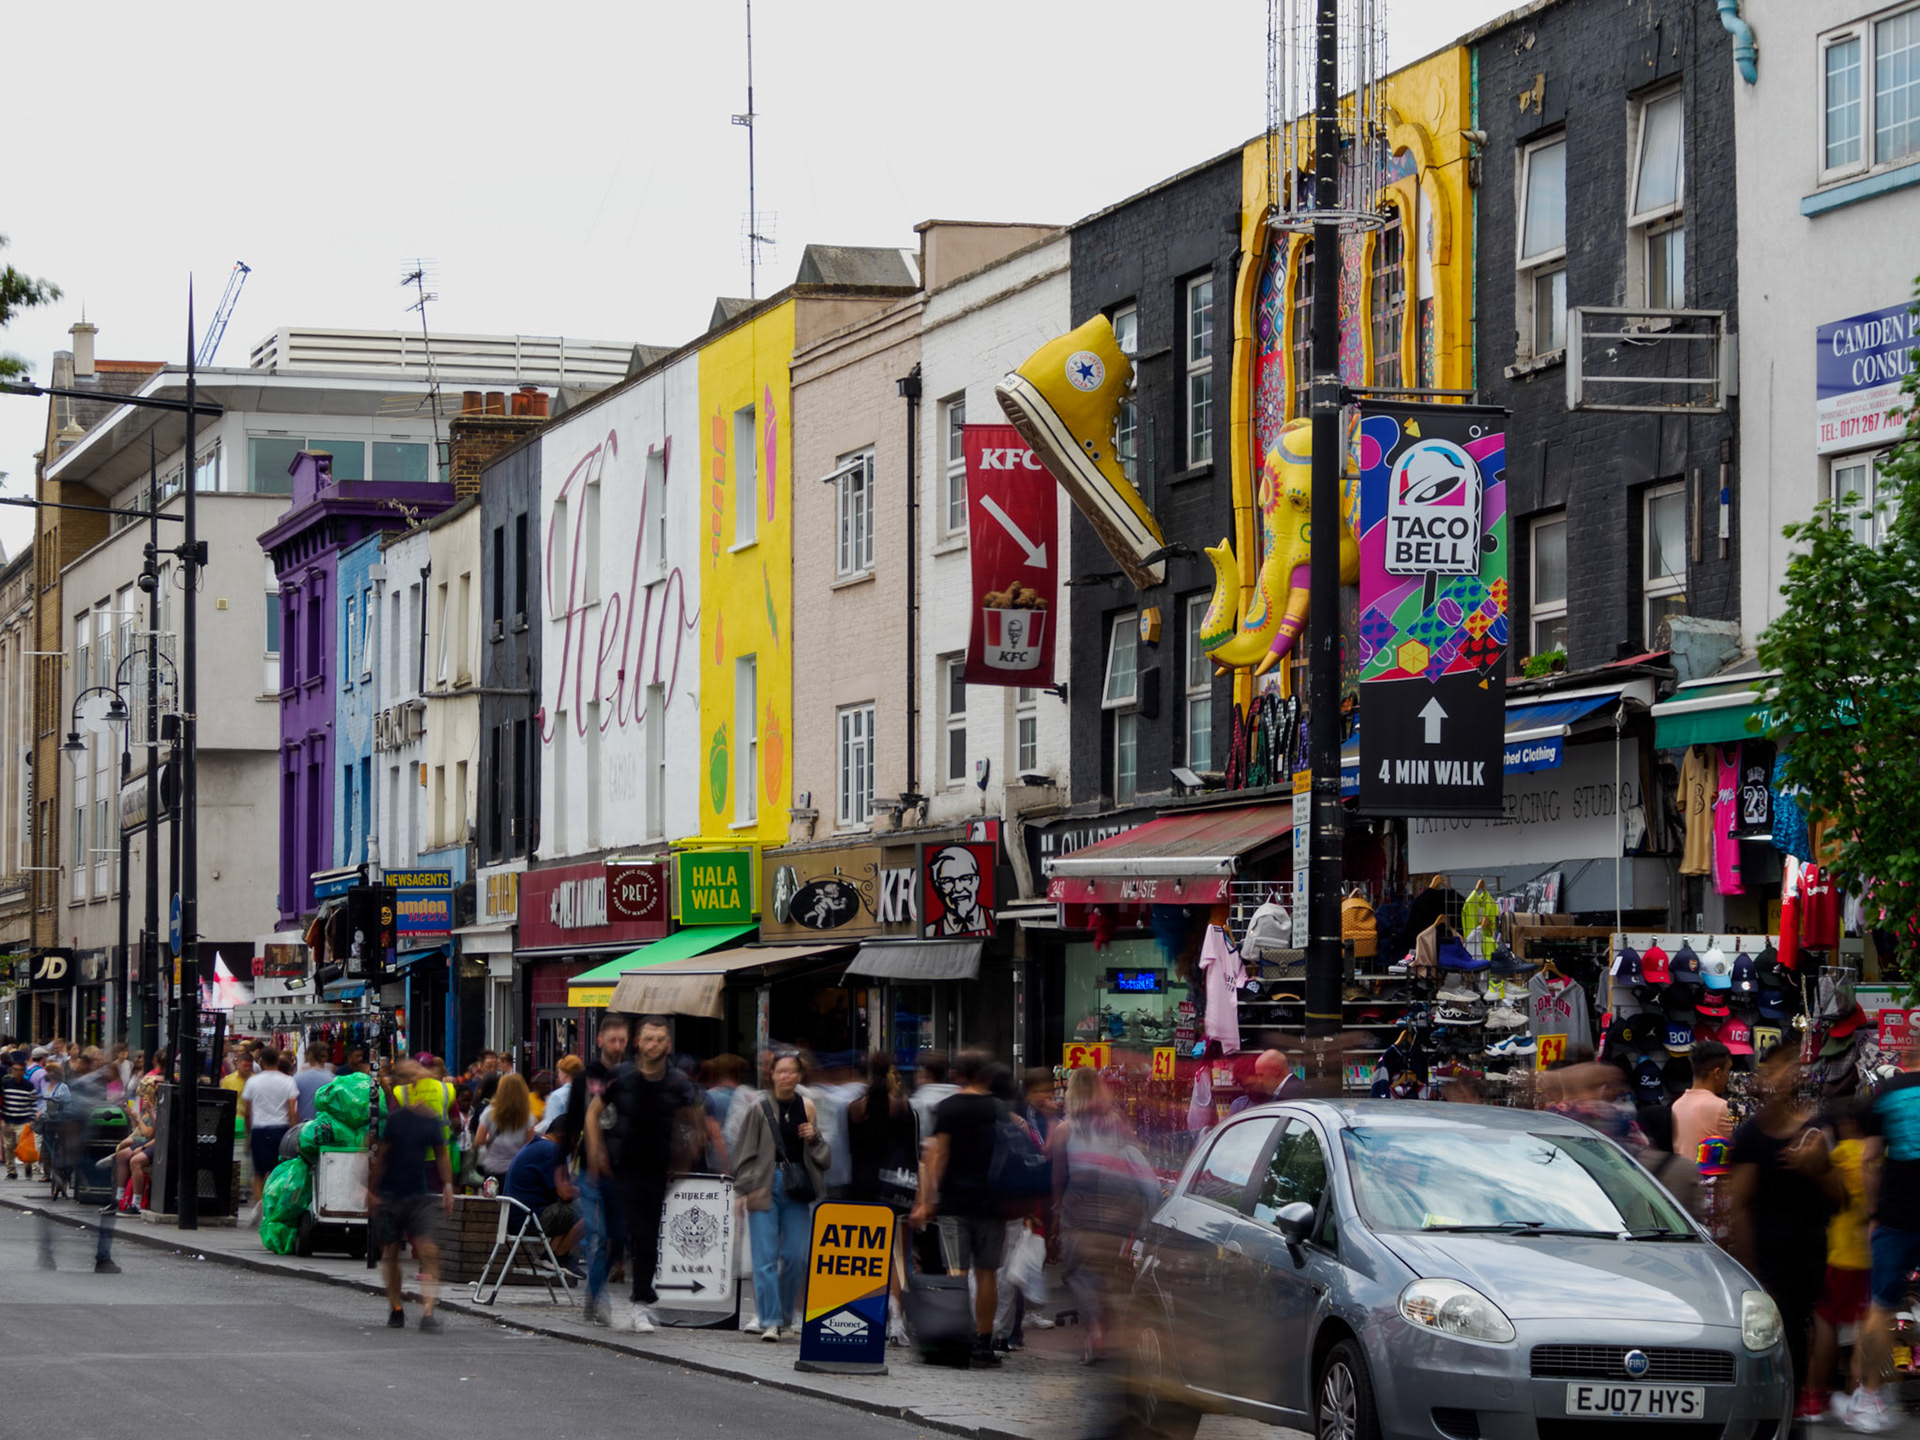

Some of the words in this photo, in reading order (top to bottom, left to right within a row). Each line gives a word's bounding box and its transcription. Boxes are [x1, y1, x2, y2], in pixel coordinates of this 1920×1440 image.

[1832, 314, 1904, 357] CAMDEN
[1852, 345, 1916, 386] CONSUL
[1821, 422, 1838, 442] TEL:
[1840, 418, 1860, 438] 0171
[1862, 412, 1880, 433] 267
[979, 448, 1043, 471] KFC
[1391, 516, 1469, 540] TACO
[1395, 542, 1466, 564] BELL
[535, 429, 700, 744] Hello
[999, 650, 1029, 663] KFC
[1522, 746, 1557, 763] Clothing
[1379, 759, 1391, 784] 4
[1396, 759, 1430, 785] MIN
[1433, 760, 1486, 786] WALK
[1743, 785, 1769, 824] 23
[386, 873, 449, 887] NEWSAGENTS
[613, 869, 636, 886] ORGANIC
[636, 869, 656, 885] COFFEE
[692, 866, 738, 887] HALA
[622, 884, 649, 902] PRET
[691, 888, 741, 910] WALA
[1050, 880, 1066, 898] 243
[397, 898, 447, 916] amden
[408, 910, 449, 922] news
[613, 896, 631, 915] FRESHLY
[632, 908, 648, 916] MADE
[646, 896, 658, 911] FOOD
[34, 956, 68, 980] JD
[1669, 1030, 1692, 1044] BOY
[1069, 1046, 1102, 1070] £1
[1155, 1051, 1171, 1075] £1
[1541, 1039, 1563, 1067] £1
[819, 1223, 886, 1250] ATM
[671, 1264, 714, 1275] KARMA
[816, 1254, 884, 1277] HERE
[828, 1318, 861, 1329] Euronet
[820, 1336, 868, 1344] WORLDWIDE
[1628, 1359, 1646, 1369] FIAT
[1577, 1387, 1642, 1413] EJ07
[1649, 1389, 1695, 1415] HYS
